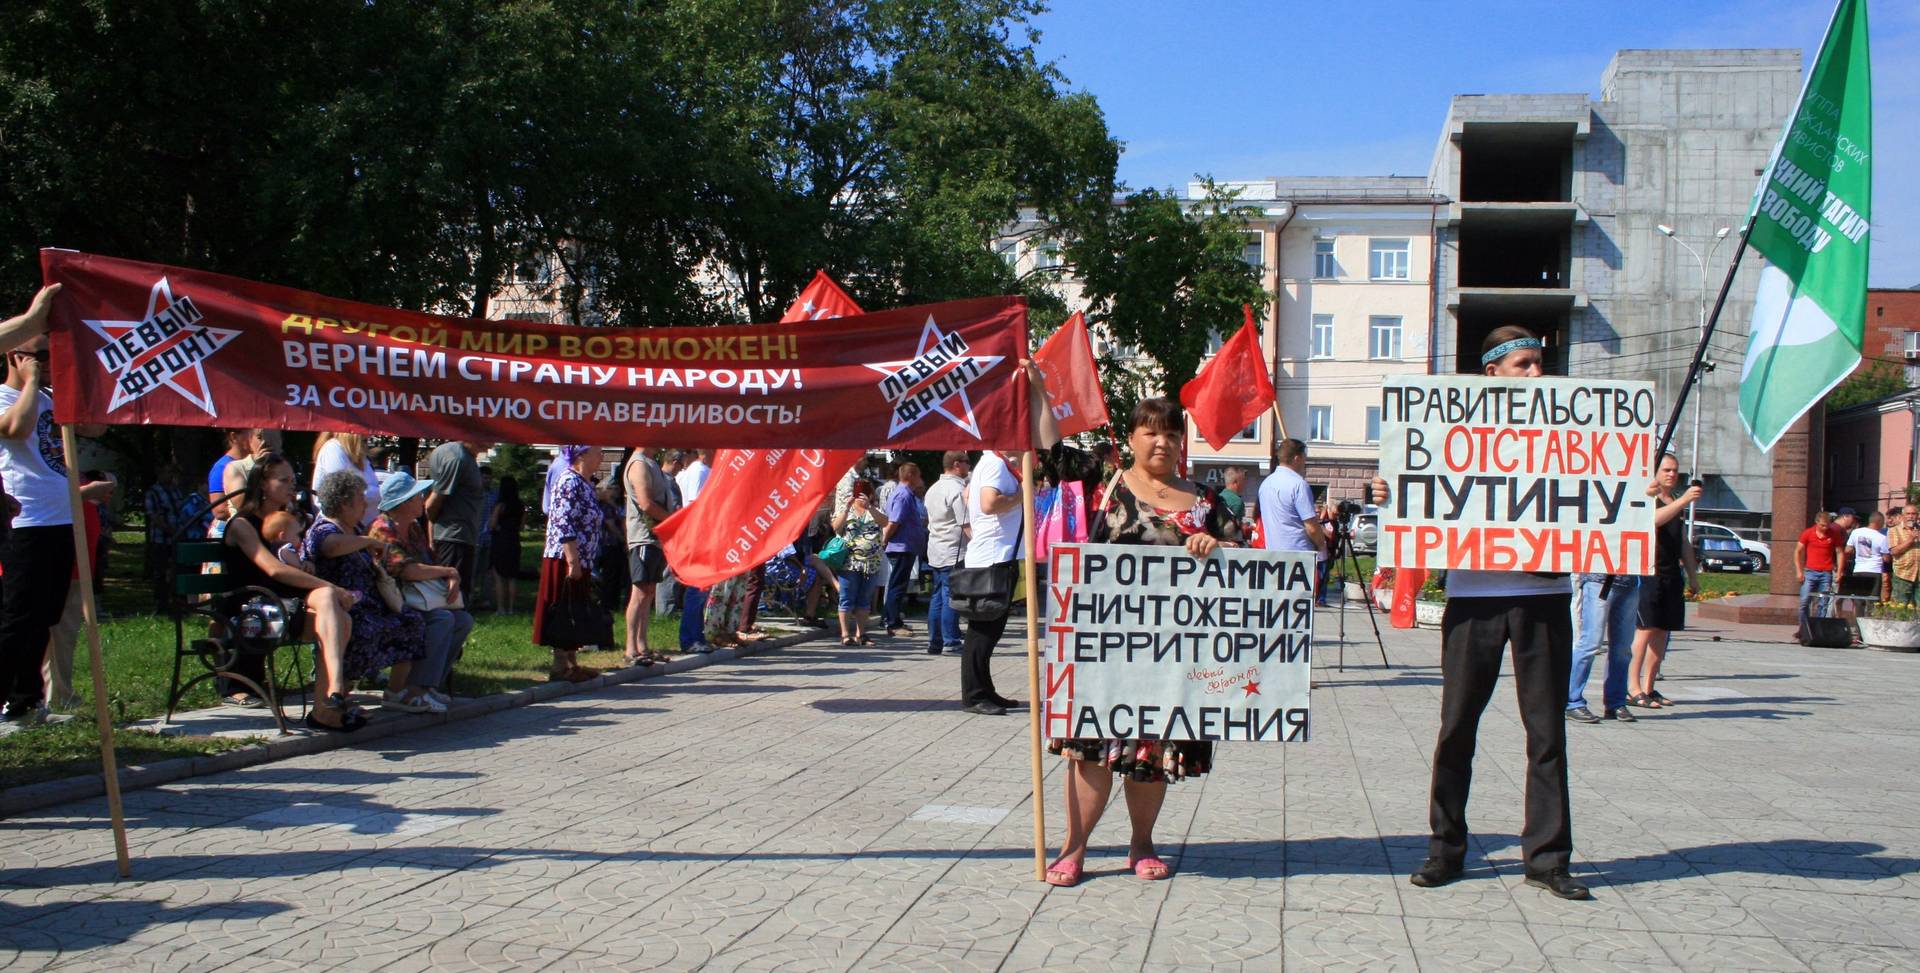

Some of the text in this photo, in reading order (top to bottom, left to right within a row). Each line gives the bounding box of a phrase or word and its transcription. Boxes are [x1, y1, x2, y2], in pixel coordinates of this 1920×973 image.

[1806, 87, 1841, 122] УППА
[1790, 126, 1845, 174] ИВИСТОВ
[1798, 108, 1869, 167] ЖДАНСКИХ
[1761, 188, 1832, 254] ВОБОДУ
[1817, 191, 1870, 244] ТАГИЛ
[120, 327, 218, 396] ФРОНТ
[281, 313, 799, 361] ДРУГОЙ МИР ВОЗМОЖЕН!
[282, 340, 803, 395] ВЕРНЕМ СТРАНУ НАРОДУ!
[896, 357, 983, 424] ФРОНТ
[284, 384, 802, 427] ЗА СОЦИАЛЬНУЮ СПРАВЕДЛИВОСТЬ!
[1382, 386, 1654, 428] ПРАВИТЕЛЬСТВО
[1405, 425, 1649, 477] В ОТСТАВКУ!
[1051, 547, 1312, 591] ПРОГРАММА
[1385, 524, 1649, 576] ТРИБУНАЛ
[1051, 586, 1311, 631] УНИЧТОЖЕНИЯ
[1046, 700, 1309, 742] НАСЕЛЕНИЯ
